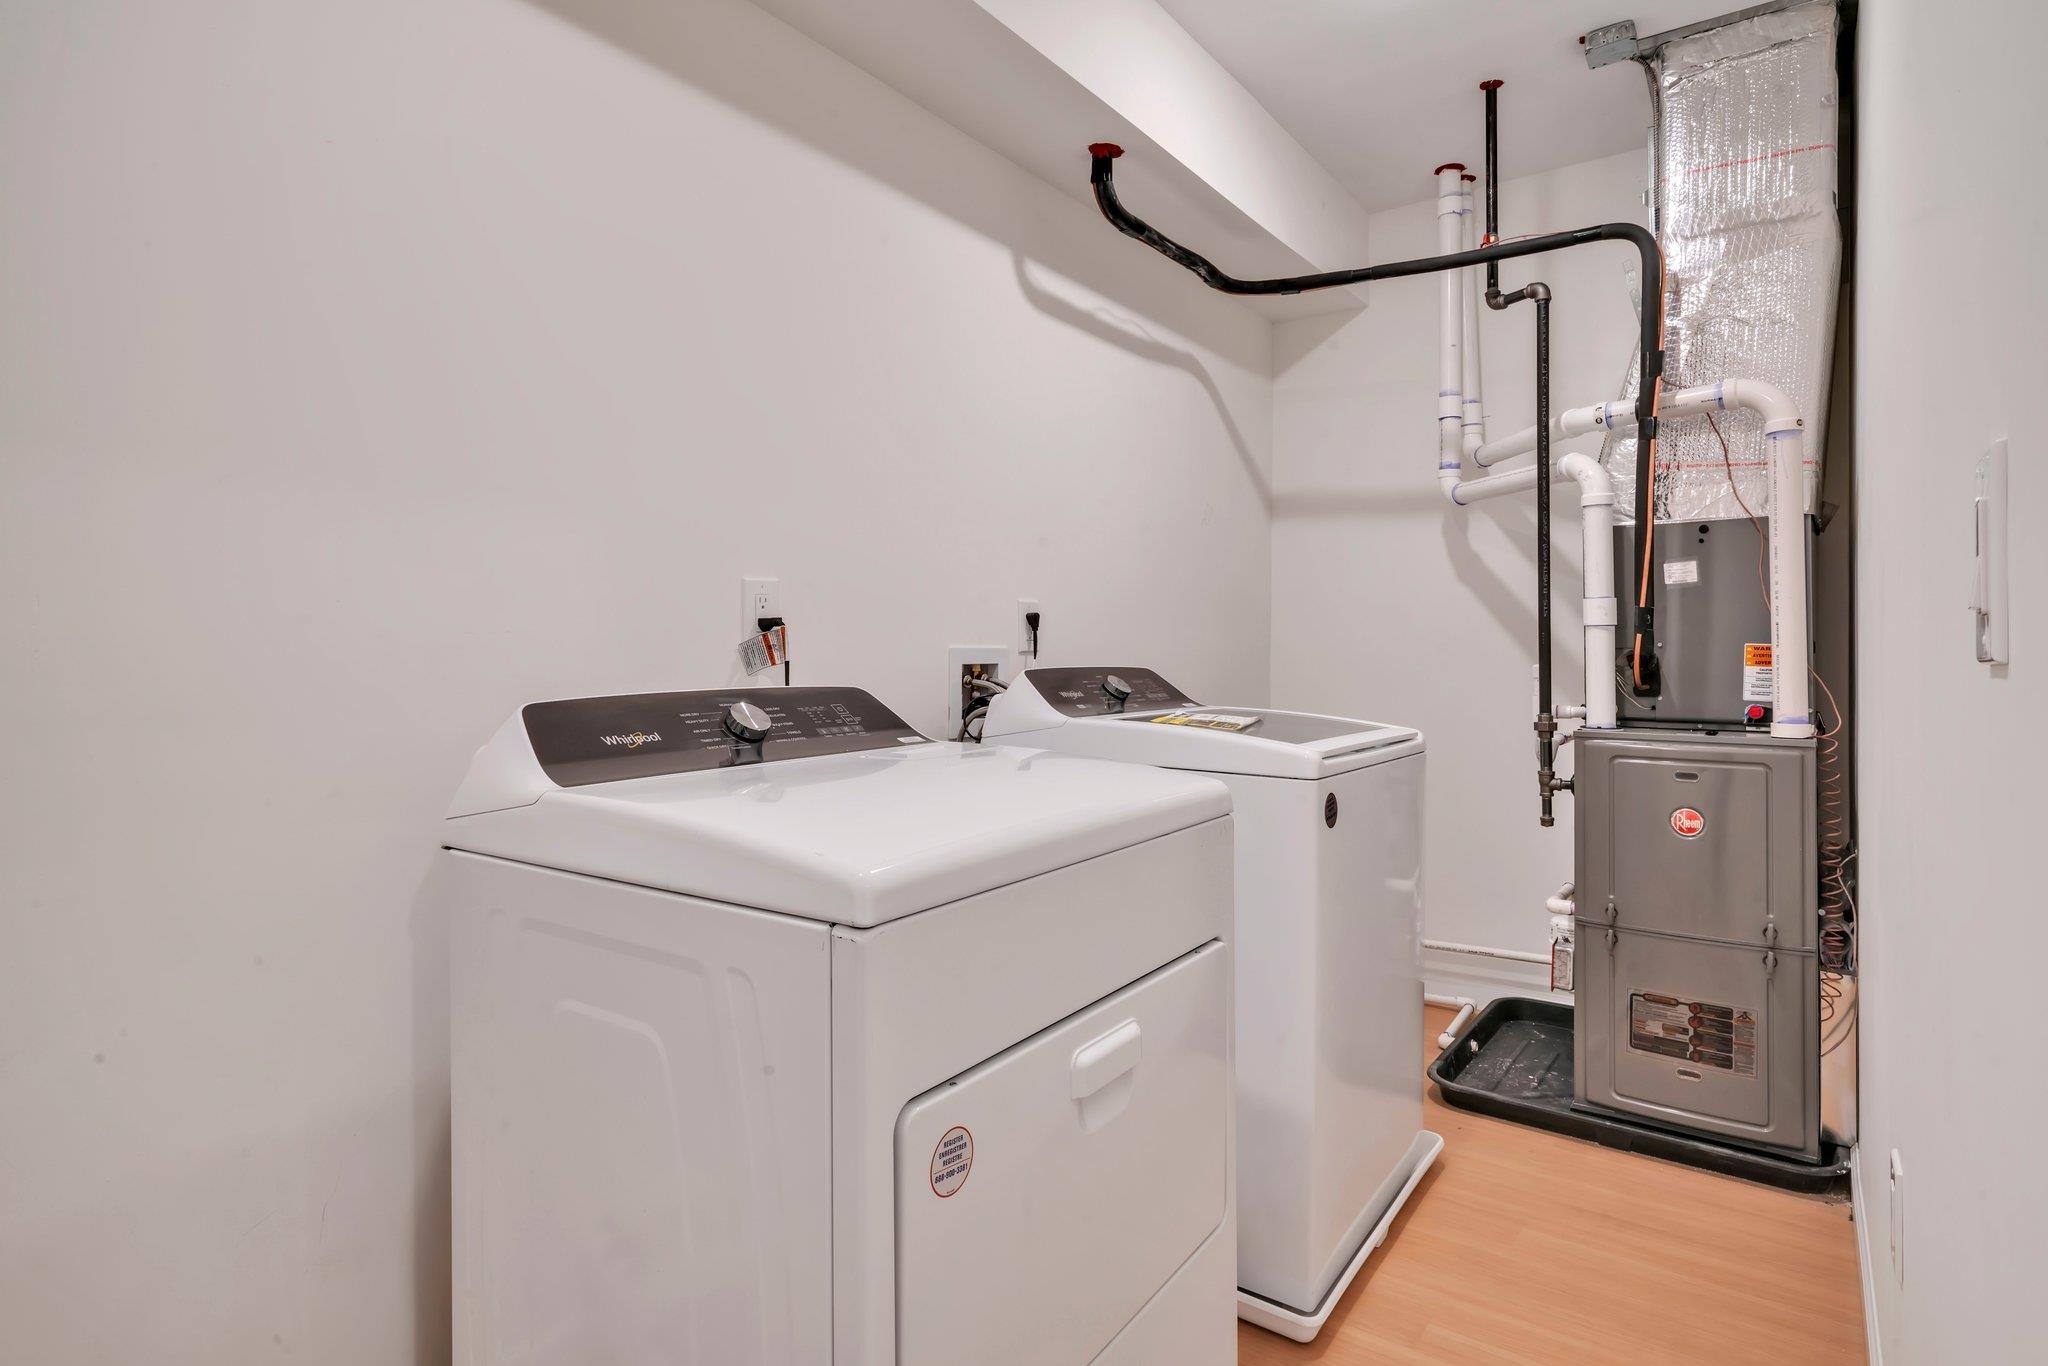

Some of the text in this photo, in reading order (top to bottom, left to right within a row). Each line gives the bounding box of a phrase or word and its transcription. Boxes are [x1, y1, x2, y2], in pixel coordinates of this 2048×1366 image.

[600, 732, 662, 747] Whirlpool
[1676, 811, 1700, 832] Rheem
[943, 1134, 964, 1149] REGISTER
[938, 1142, 967, 1160] ENREGISTRER
[942, 1152, 963, 1167] REGISTRE
